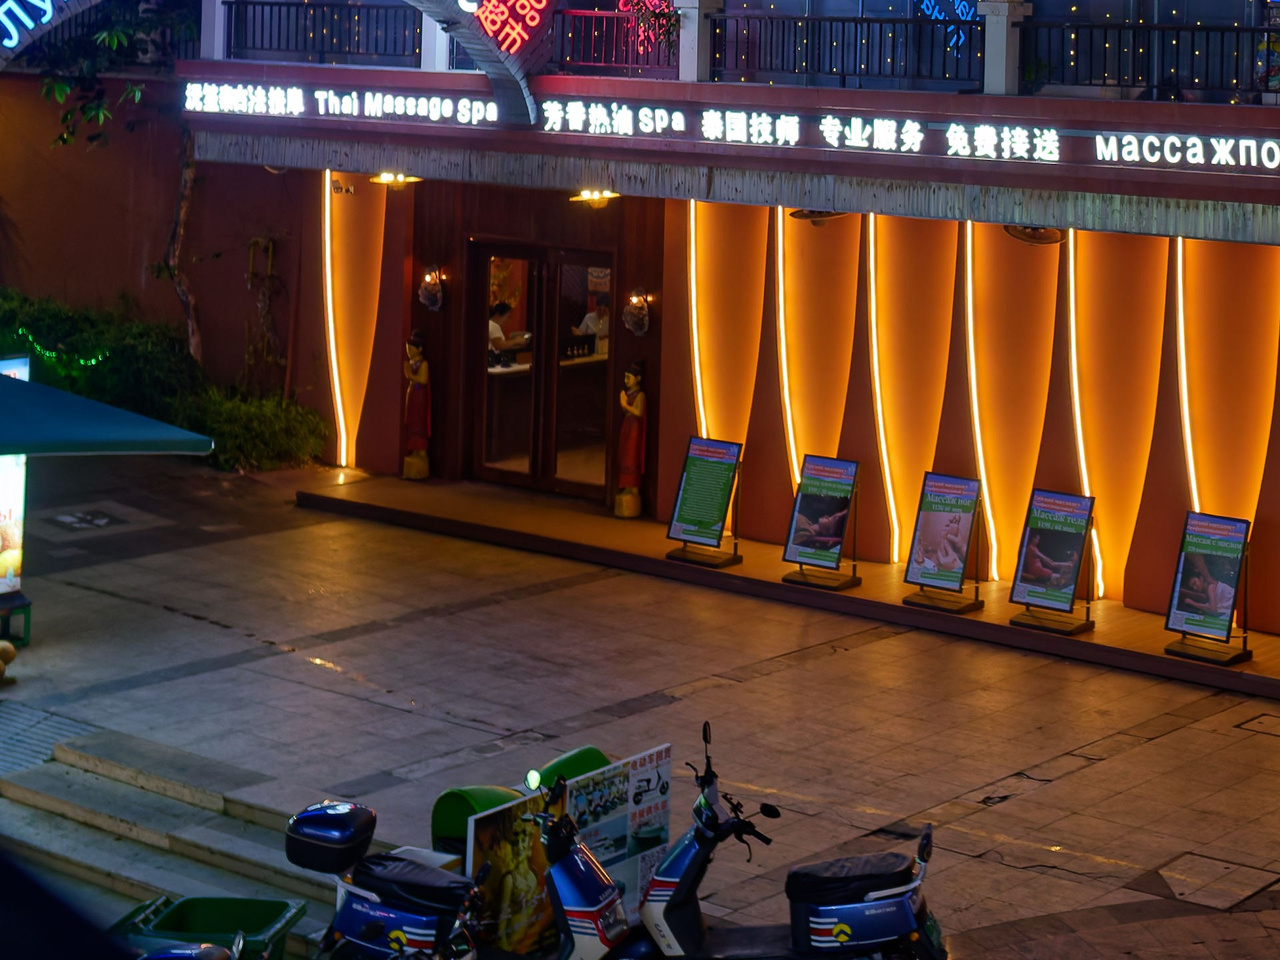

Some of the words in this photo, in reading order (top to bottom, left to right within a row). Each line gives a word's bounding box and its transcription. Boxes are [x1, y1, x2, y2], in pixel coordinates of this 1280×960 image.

[314, 89, 358, 117] Thai
[364, 92, 453, 122] Massage
[541, 100, 634, 136] 芳香热油
[701, 109, 800, 146] 泰国技师
[819, 114, 925, 153] 专业服务
[945, 123, 1060, 162] 免费接送
